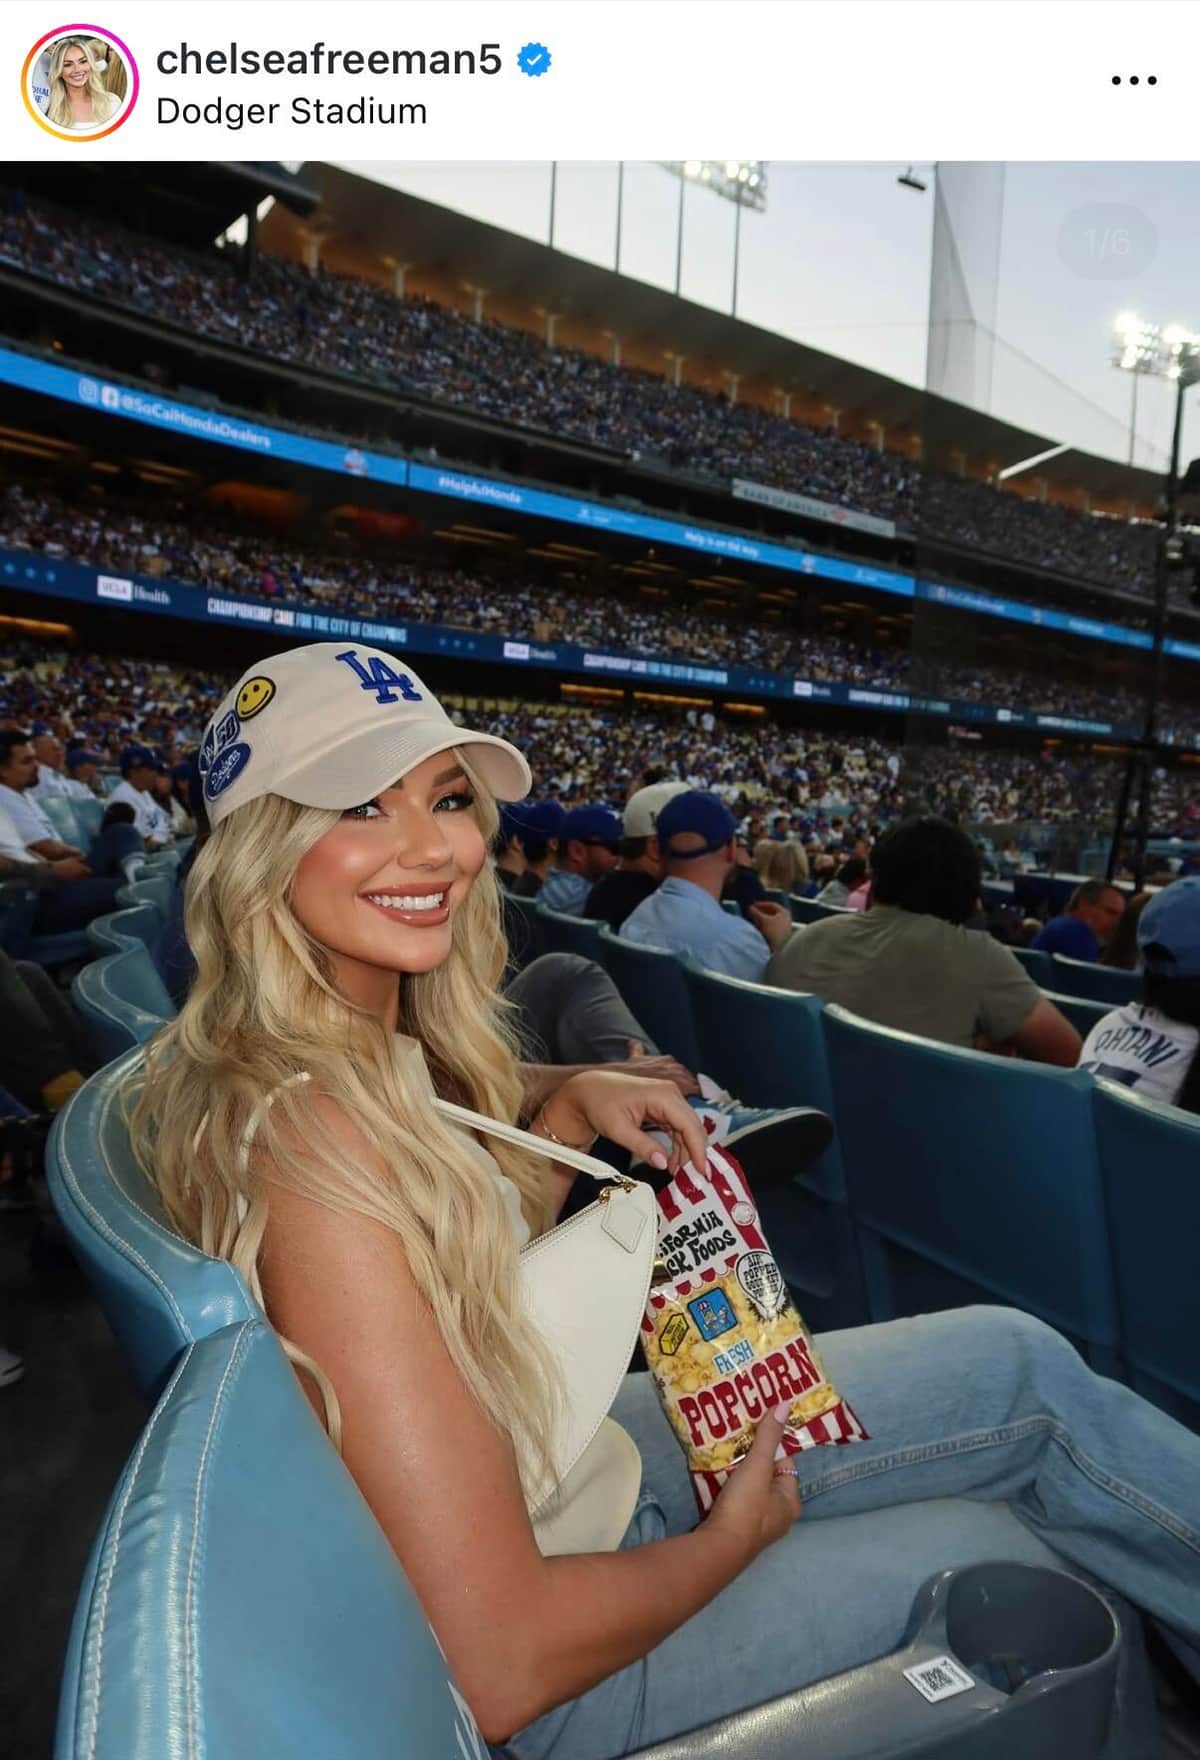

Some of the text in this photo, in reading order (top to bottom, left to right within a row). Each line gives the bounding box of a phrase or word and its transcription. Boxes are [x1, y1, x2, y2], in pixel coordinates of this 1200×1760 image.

[335, 650, 423, 704] LA
[1094, 1024, 1180, 1068] OHTANI
[686, 1229, 737, 1266] FOODS
[714, 1339, 755, 1375] FRESH
[678, 1336, 821, 1448] POPCORN
